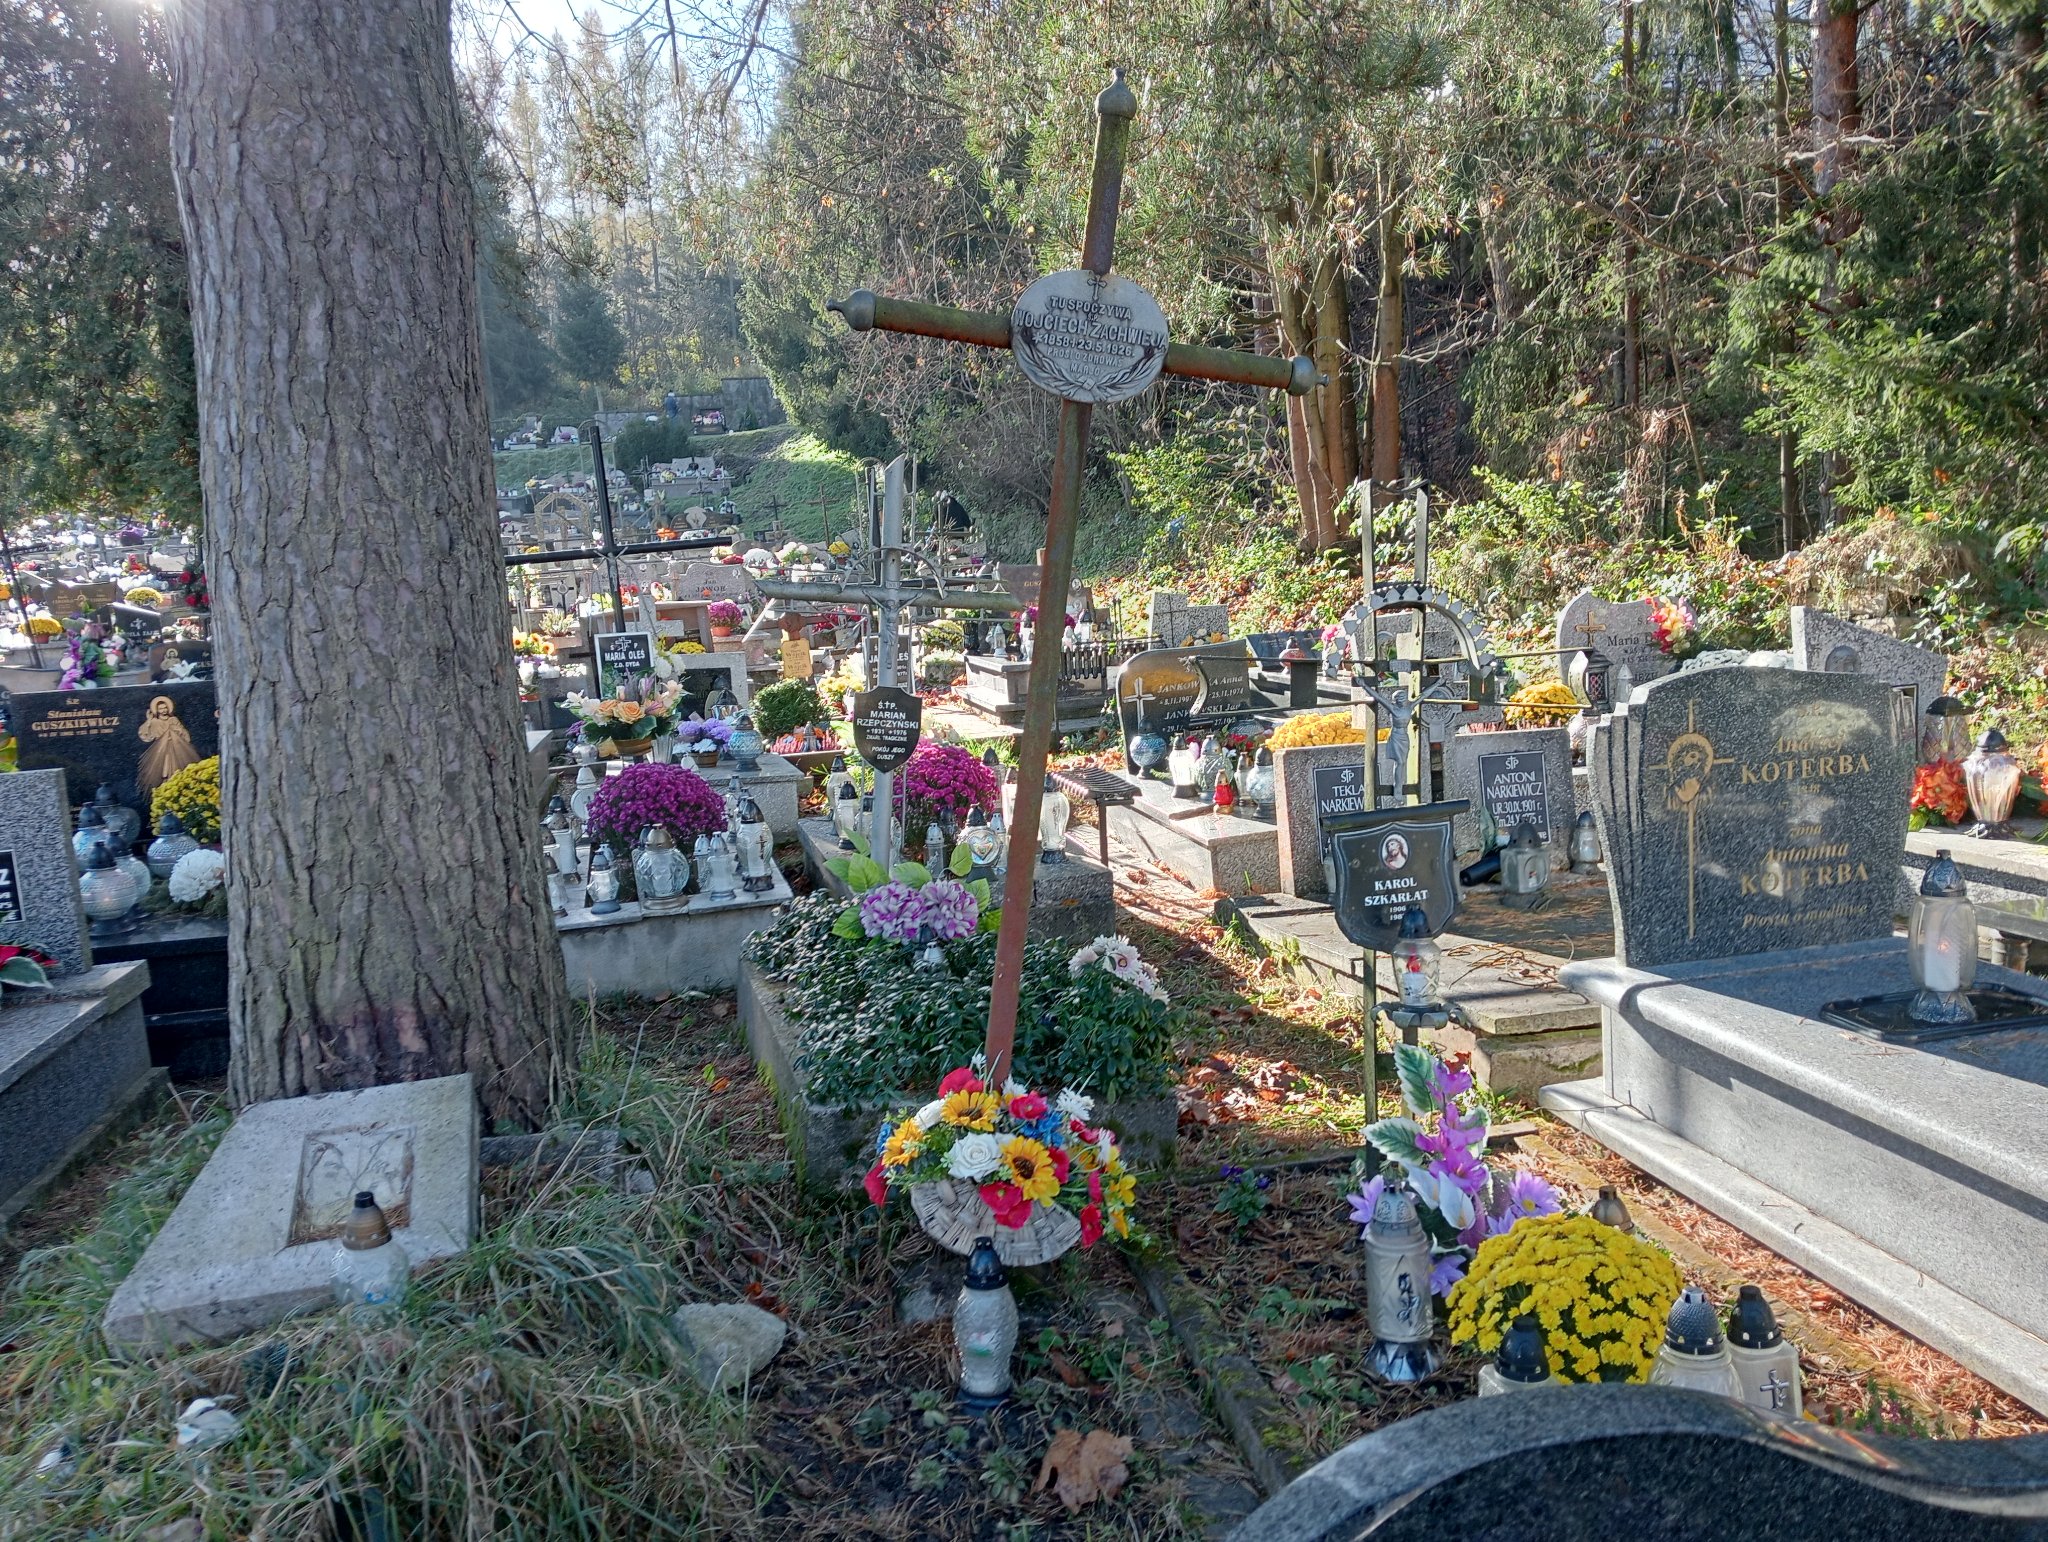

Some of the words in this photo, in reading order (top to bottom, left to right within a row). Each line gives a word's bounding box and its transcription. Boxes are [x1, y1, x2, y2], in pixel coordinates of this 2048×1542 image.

[1051, 296, 1066, 310] TU
[1066, 299, 1132, 320] SPOCZYWA
[1014, 309, 1088, 336] WOJCIECH
[1089, 321, 1169, 351] ZACHWIEJA
[604, 651, 626, 662] MARIA
[628, 648, 646, 660] OLEŚ
[870, 710, 906, 720] MARIAN
[31, 716, 121, 732] GUSZKIEWICZ
[856, 718, 919, 729] RZEPCZYŃSKI
[1741, 753, 1871, 785] KOTERBA
[1493, 771, 1536, 785] ANTONI
[1332, 783, 1365, 798] TEKLA
[1486, 782, 1544, 800] NARKIEWICZ
[1374, 877, 1418, 892] KAROL
[1741, 863, 1869, 896] KOTERBA
[1364, 889, 1429, 907] SZKARŁAT
